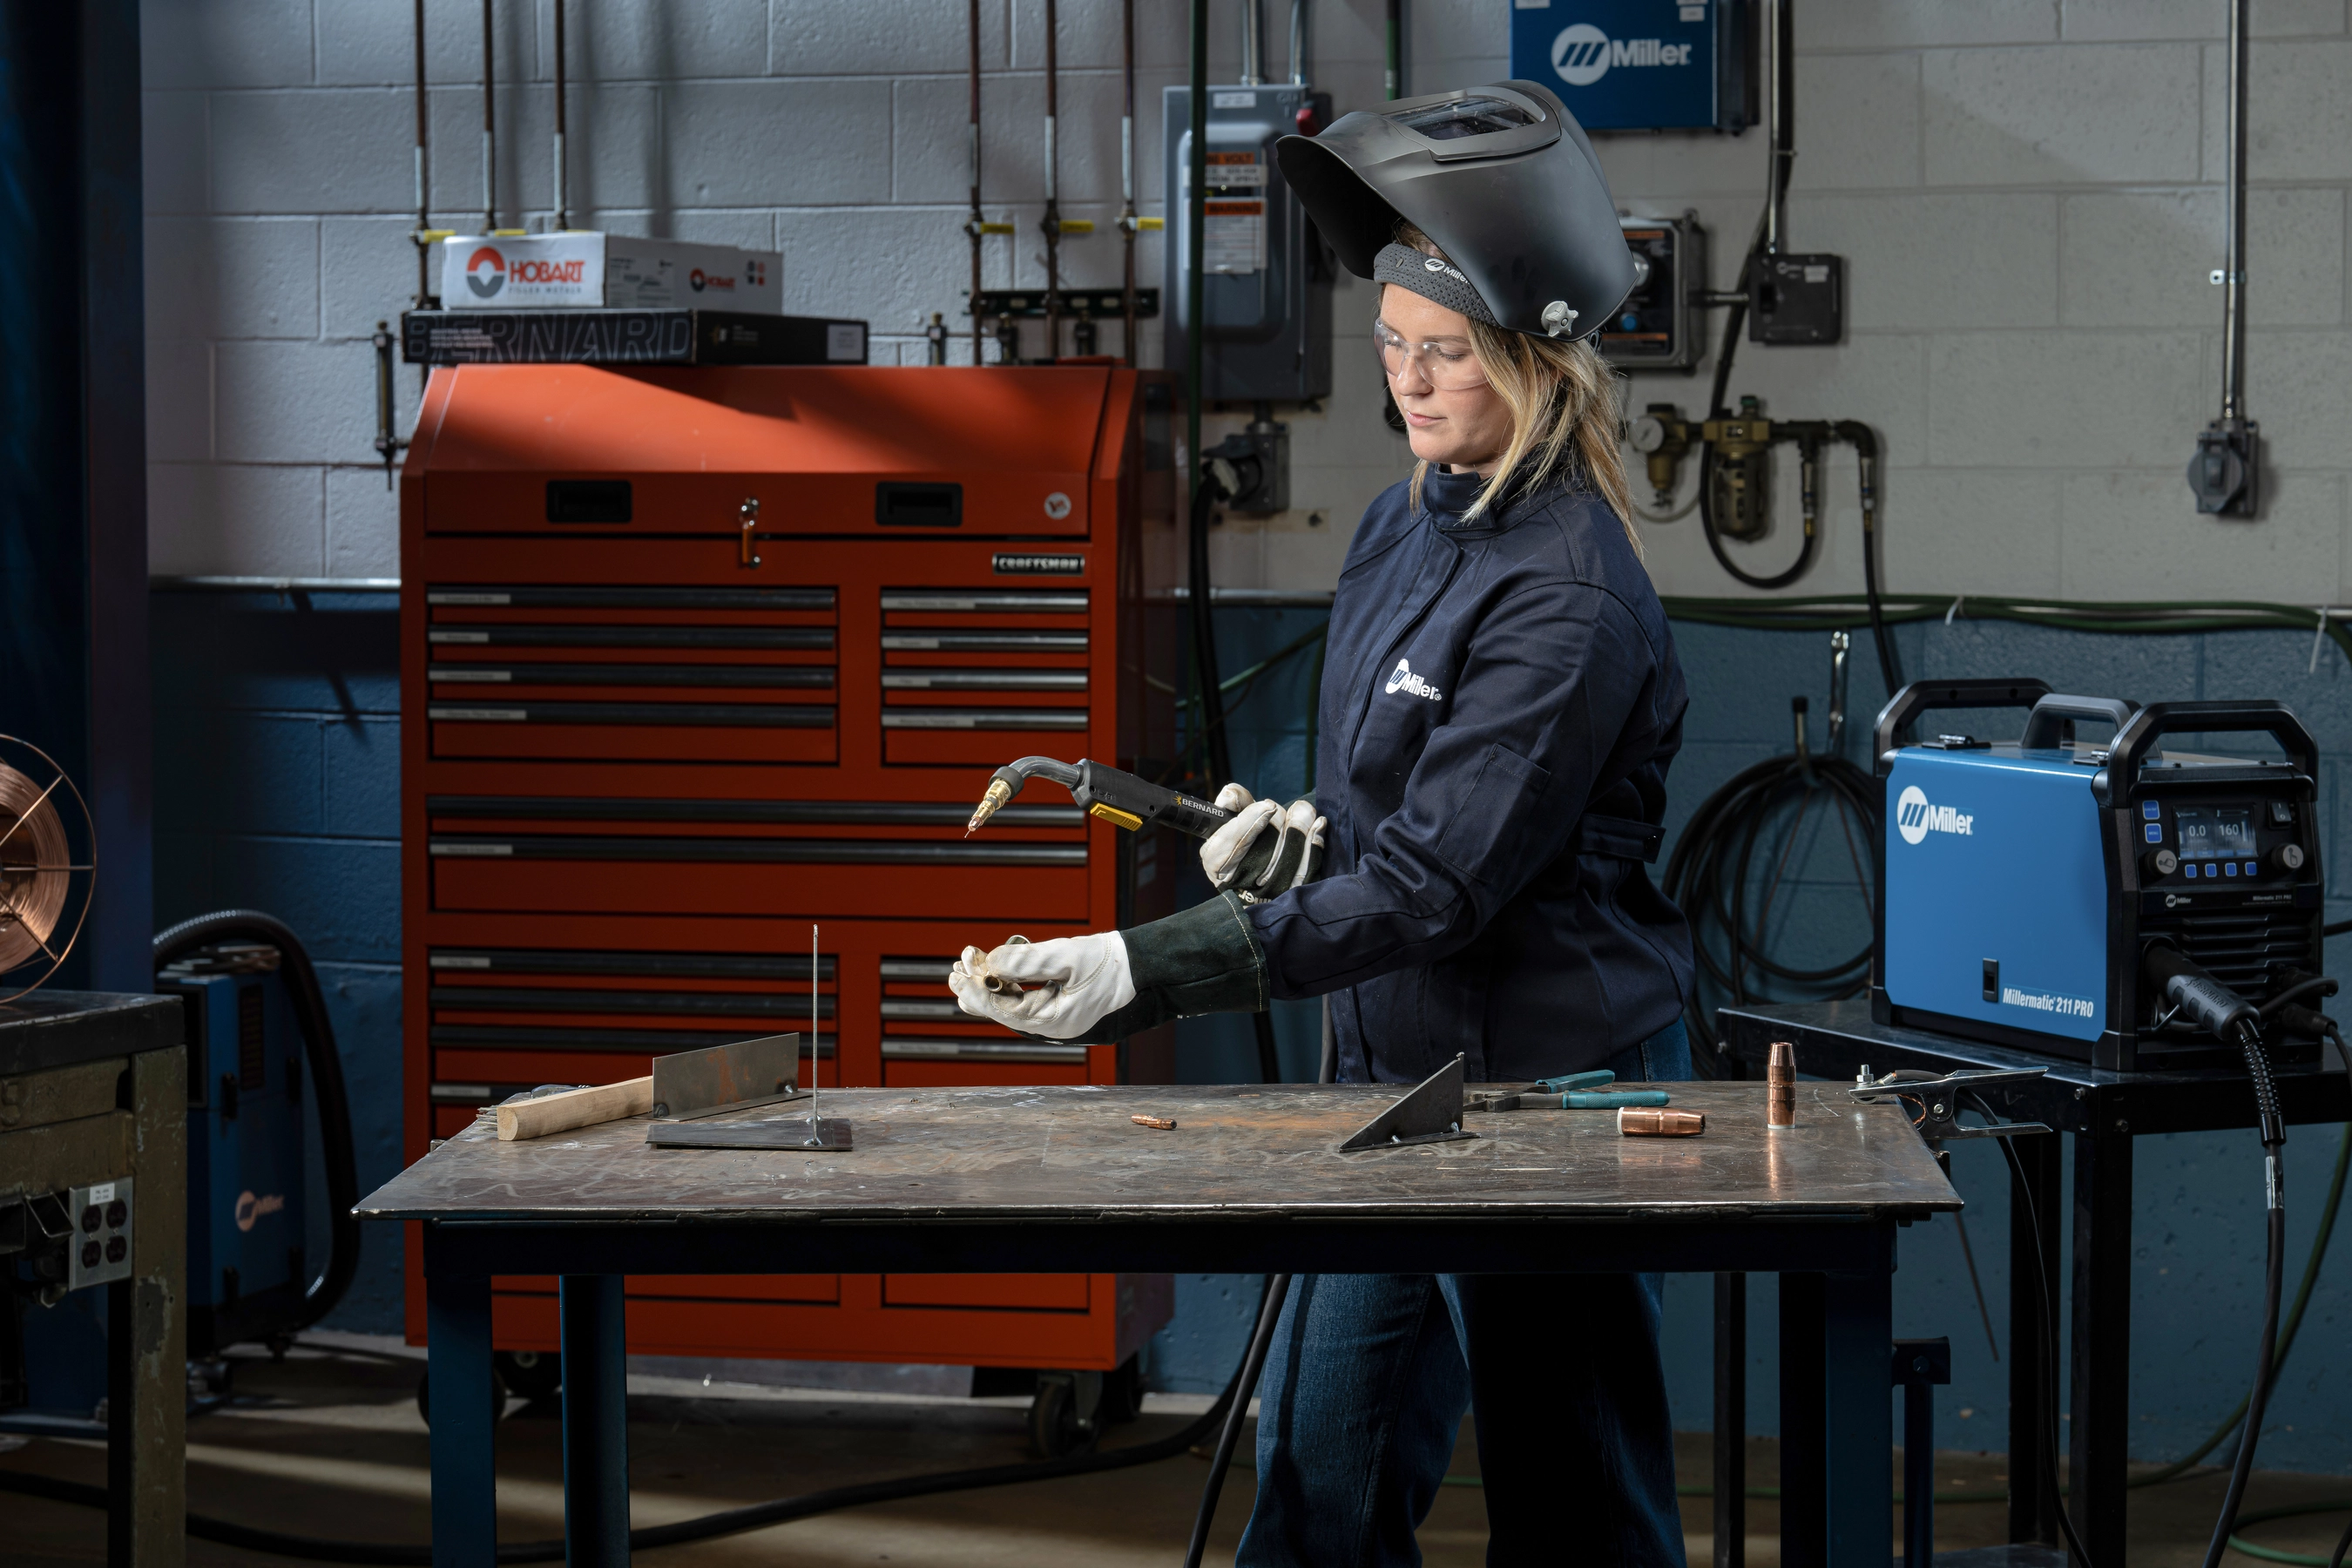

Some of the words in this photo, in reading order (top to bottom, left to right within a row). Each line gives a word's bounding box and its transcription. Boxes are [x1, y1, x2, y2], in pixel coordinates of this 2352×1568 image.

[1612, 39, 1692, 67] Miller
[509, 260, 585, 283] HOBART
[998, 558, 1079, 570] CRAFTSMAN
[1182, 798, 1224, 817] BERNARD
[1930, 804, 1973, 835] Miller
[2188, 824, 2206, 836] 0.0
[2219, 823, 2239, 835] 160
[2056, 997, 2072, 1014] 211
[2073, 999, 2094, 1017] PRO
